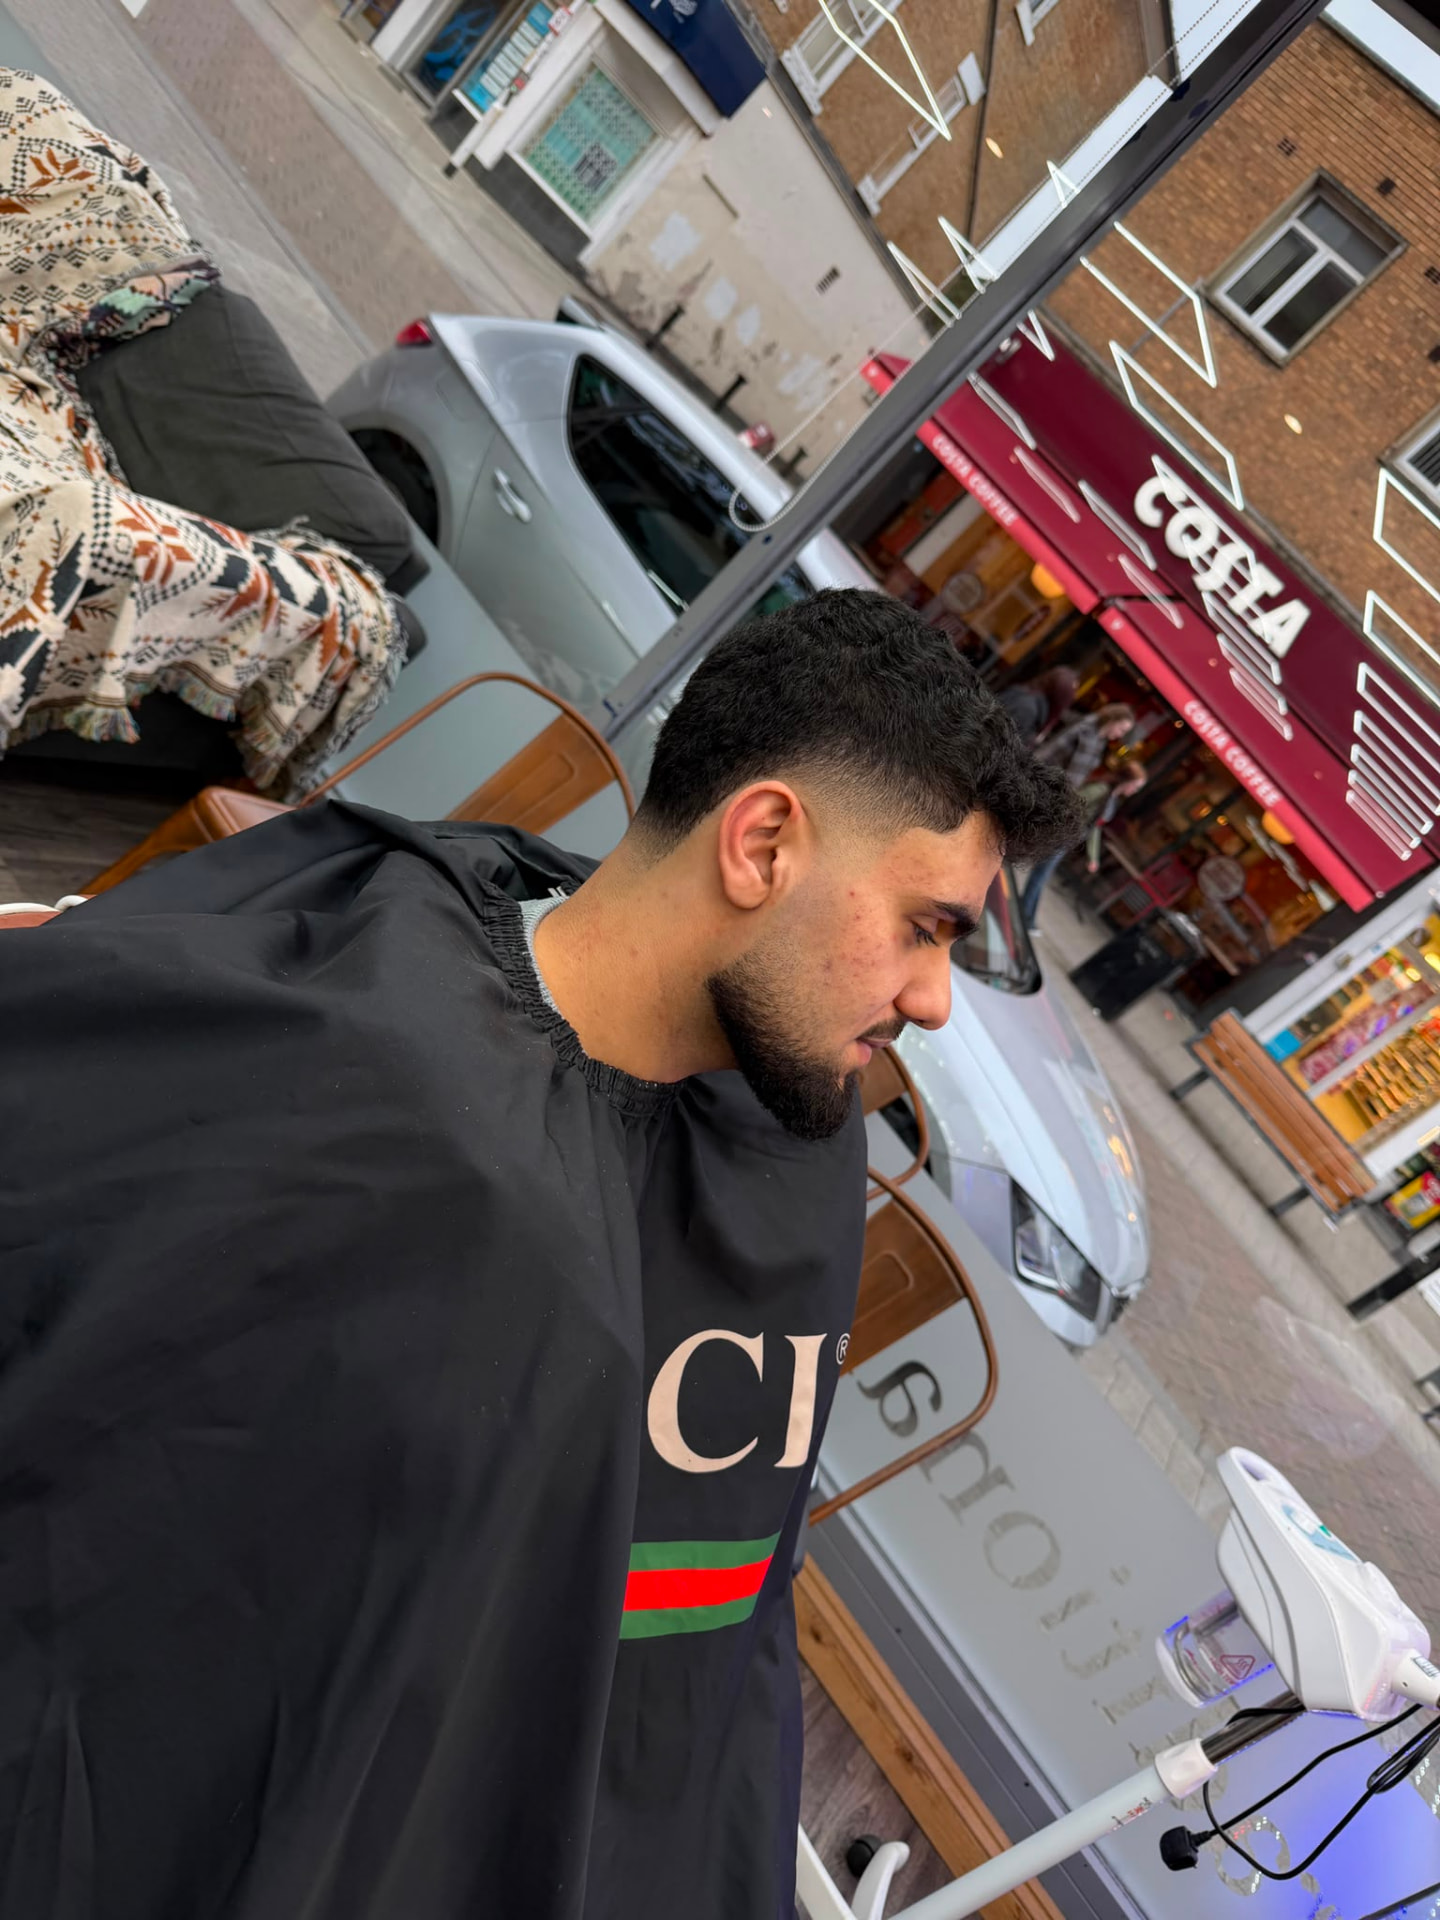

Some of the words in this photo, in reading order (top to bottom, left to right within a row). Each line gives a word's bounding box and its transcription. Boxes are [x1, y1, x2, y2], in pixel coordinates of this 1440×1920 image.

[932, 433, 973, 478] COSTA
[969, 472, 1018, 527] COFFEE
[1134, 475, 1311, 659] COSTA
[1184, 700, 1231, 752] COSTA
[1225, 746, 1281, 808] COFFEE
